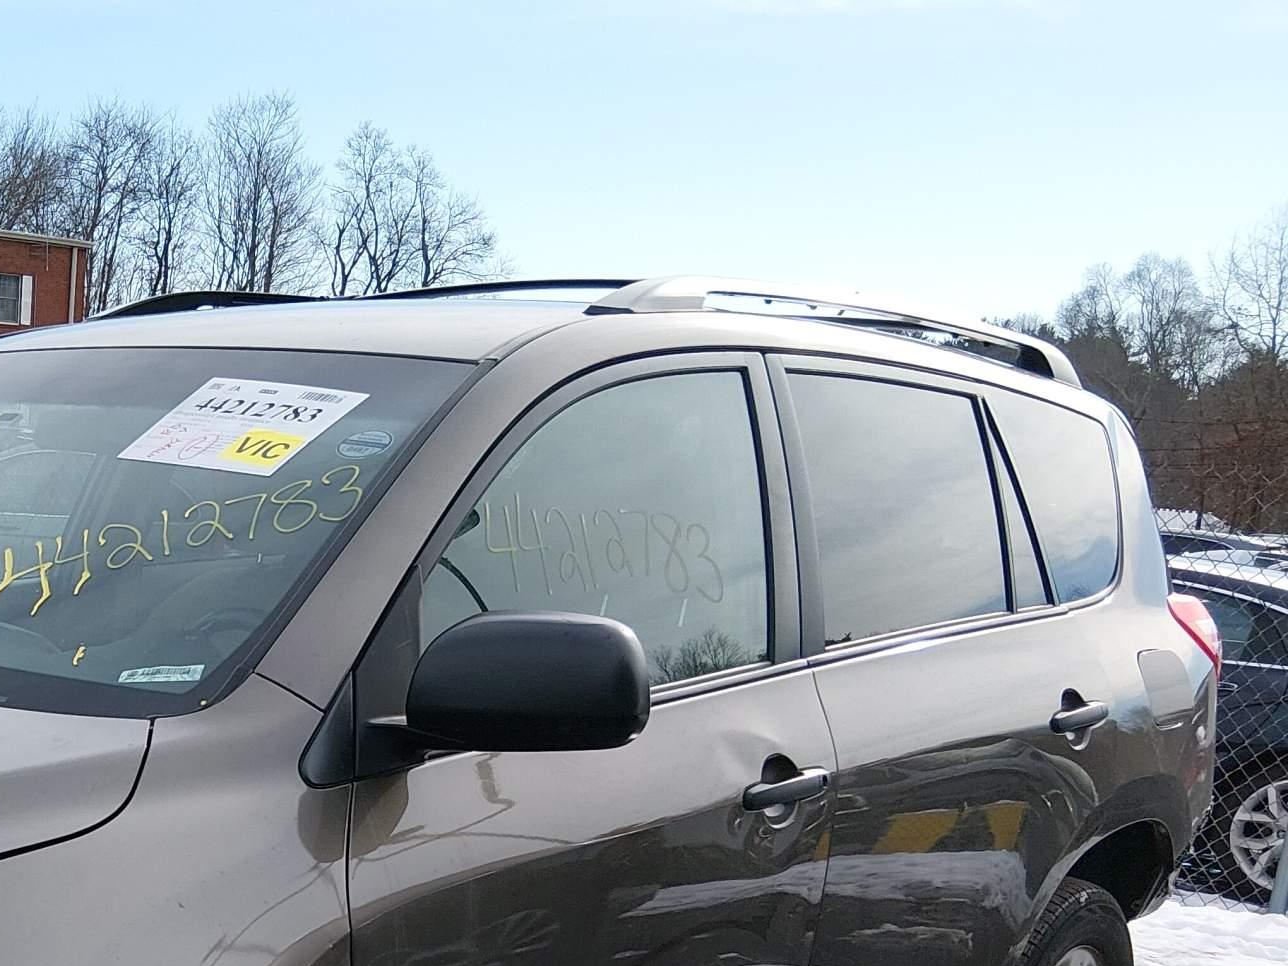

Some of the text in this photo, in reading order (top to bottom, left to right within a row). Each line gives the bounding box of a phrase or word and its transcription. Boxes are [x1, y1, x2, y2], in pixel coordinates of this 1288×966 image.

[194, 396, 323, 424] 44212783
[235, 436, 290, 460] VIC
[484, 492, 724, 603] 44212783
